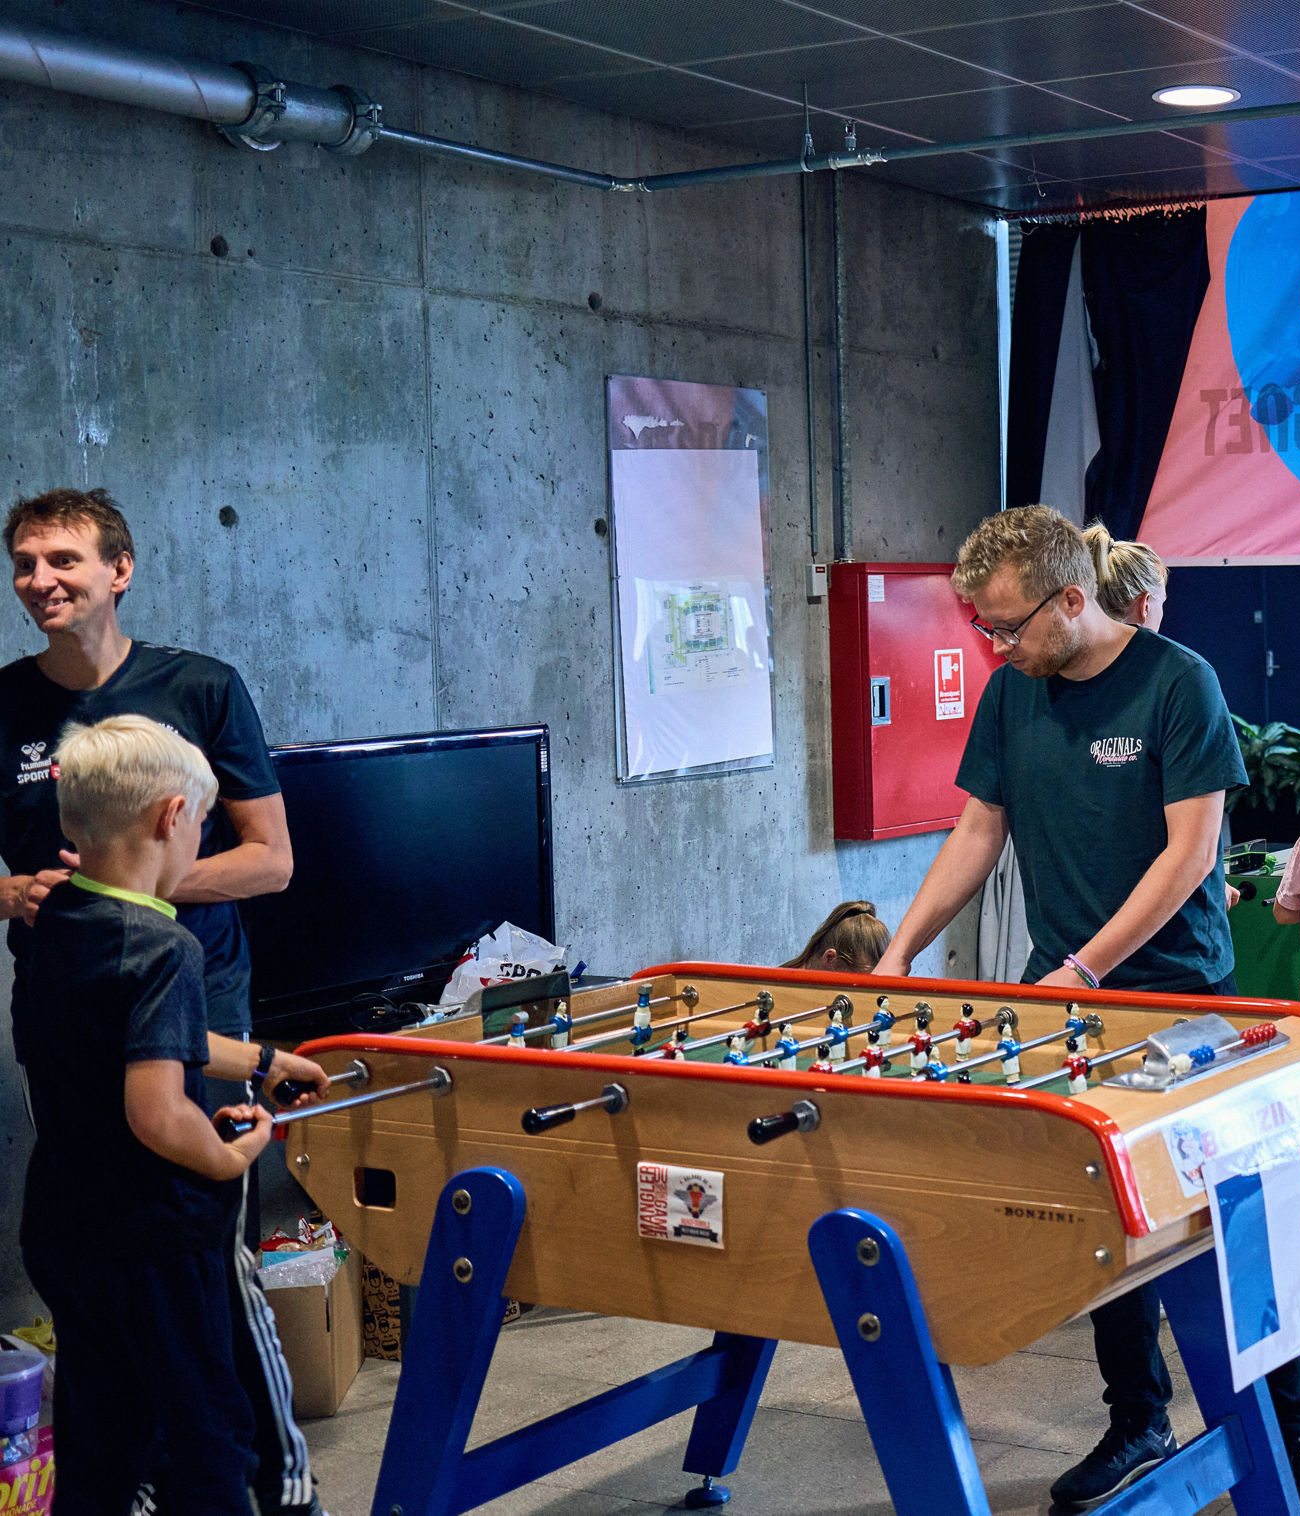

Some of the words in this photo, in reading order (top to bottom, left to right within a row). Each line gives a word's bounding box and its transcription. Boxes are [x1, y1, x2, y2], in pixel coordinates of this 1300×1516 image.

[1090, 737, 1142, 758] ORIGINALS
[20, 757, 52, 771] hummel
[17, 769, 50, 784] SPORT
[403, 972, 424, 982] TOSHIBA
[639, 1165, 657, 1237] MANGLER
[1004, 1206, 1075, 1224] BONZINI
